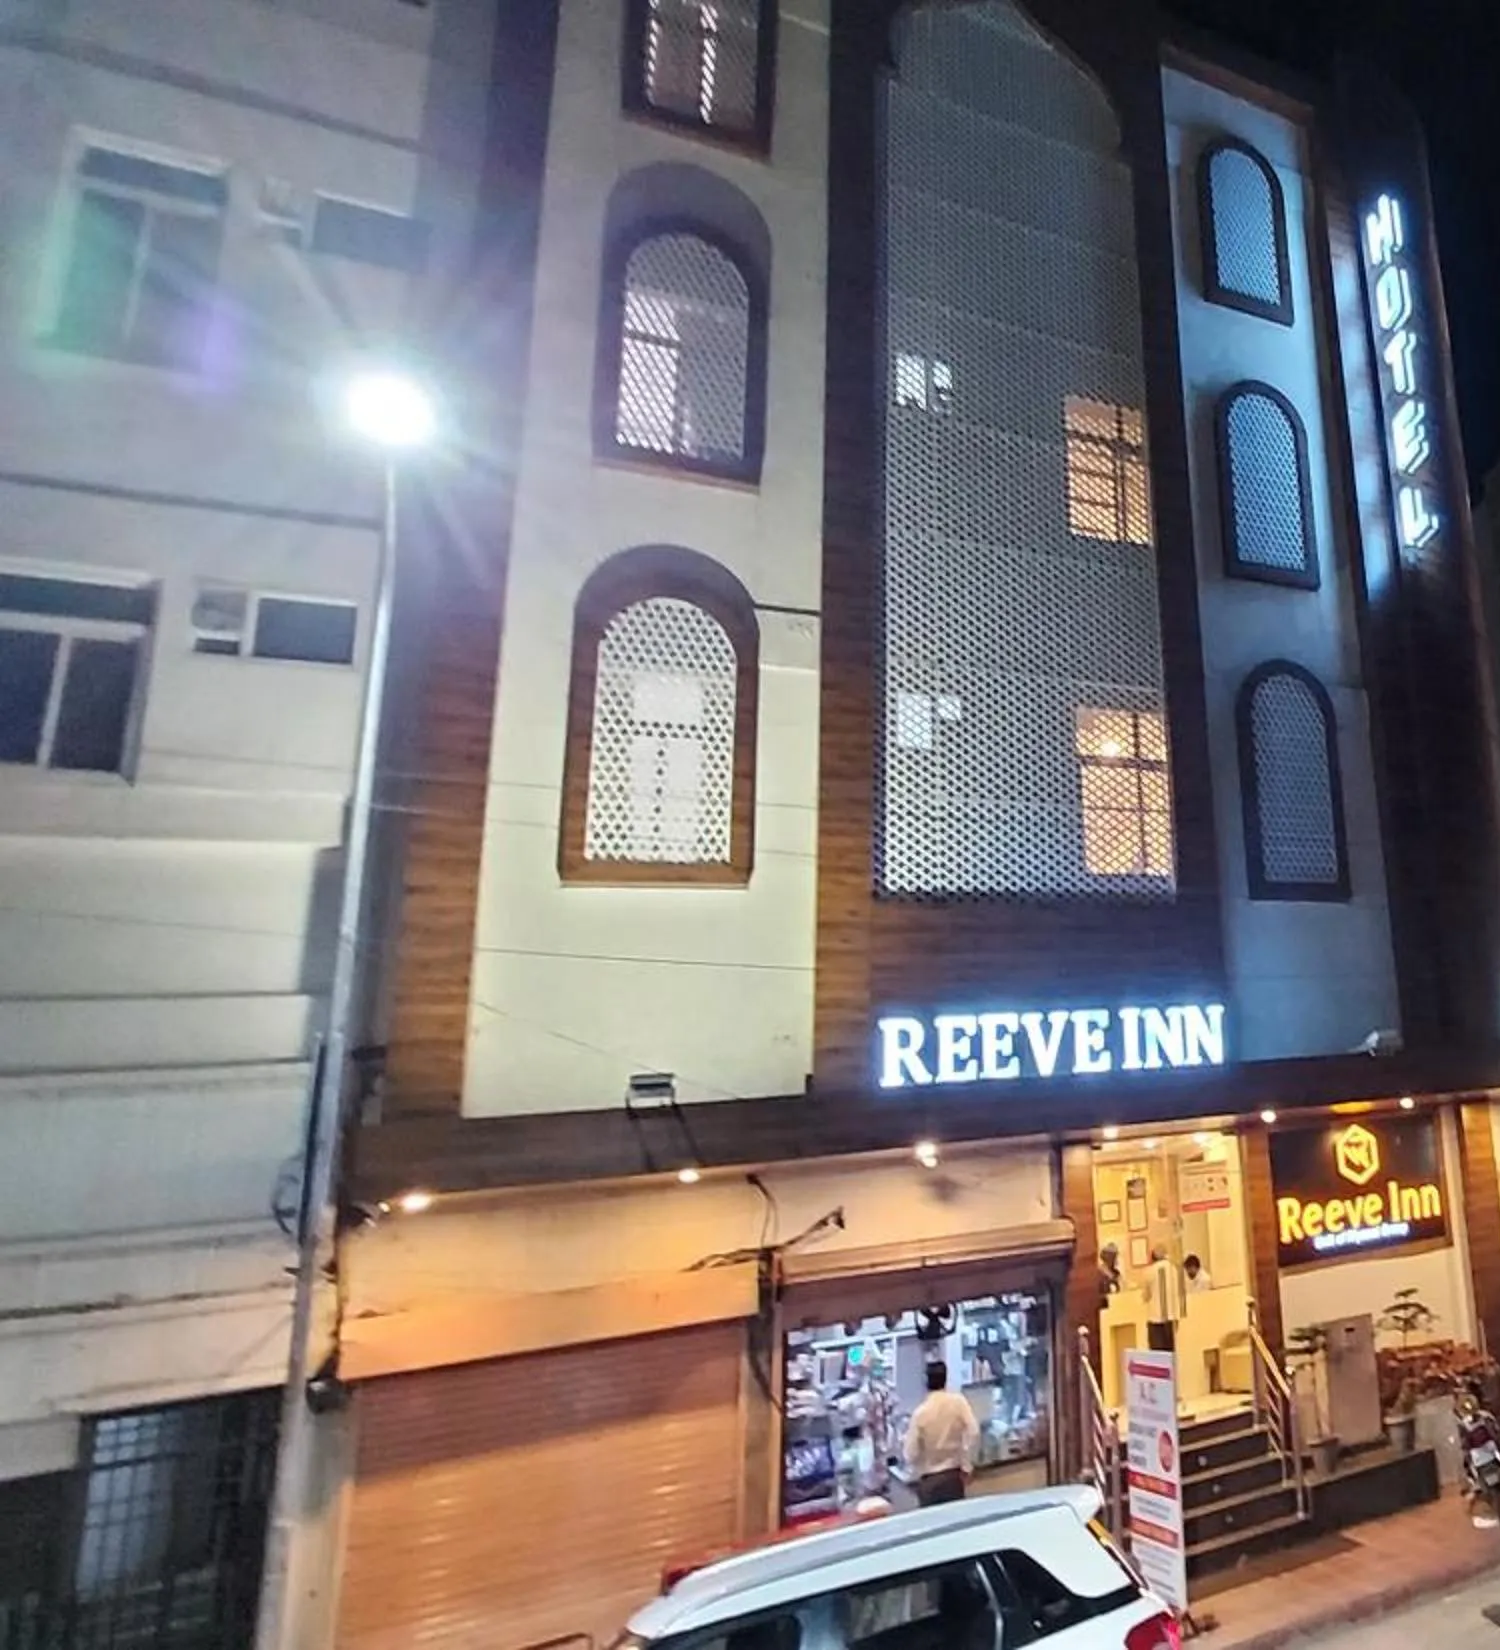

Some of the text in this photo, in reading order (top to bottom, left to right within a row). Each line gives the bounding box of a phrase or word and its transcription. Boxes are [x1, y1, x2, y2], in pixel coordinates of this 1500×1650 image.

[1366, 193, 1439, 549] HOTEL
[877, 1003, 1225, 1088] REEVE INN
[1277, 1192, 1384, 1245] Reeve
[1387, 1180, 1442, 1222] Inn
